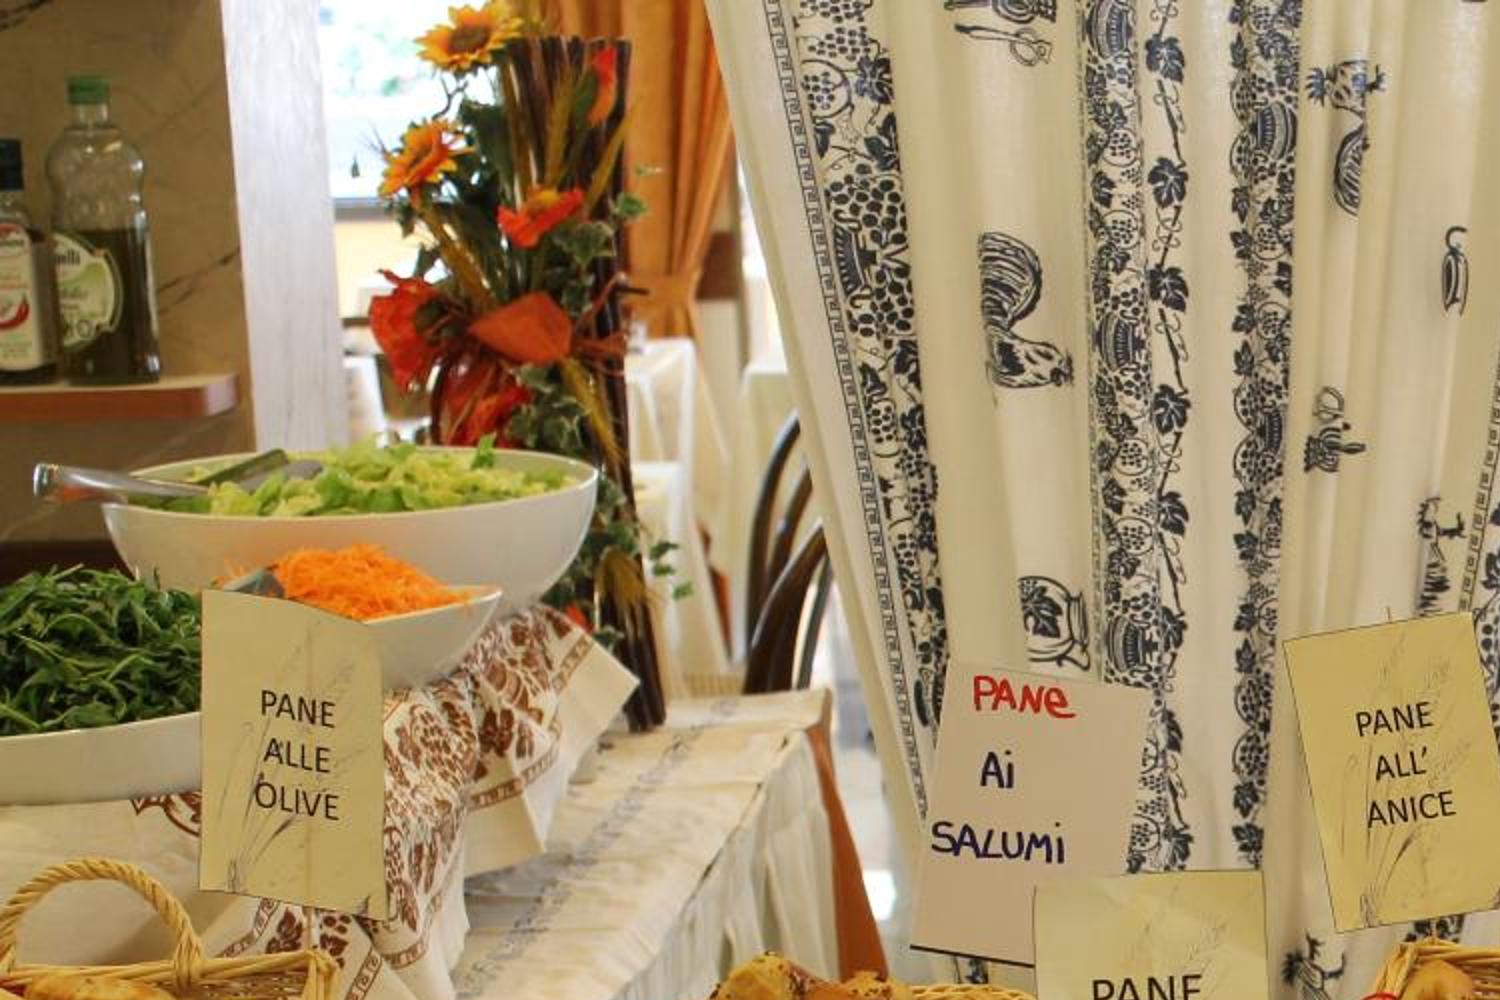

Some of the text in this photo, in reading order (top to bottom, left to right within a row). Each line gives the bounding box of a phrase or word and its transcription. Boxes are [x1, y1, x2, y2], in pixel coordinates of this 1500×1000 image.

[261, 689, 336, 728] PANE
[1355, 701, 1434, 737] PANE
[263, 737, 331, 773] ALLE
[1375, 746, 1428, 781] ALL'
[255, 780, 339, 821] OLIVE
[1367, 790, 1457, 829] ANICE
